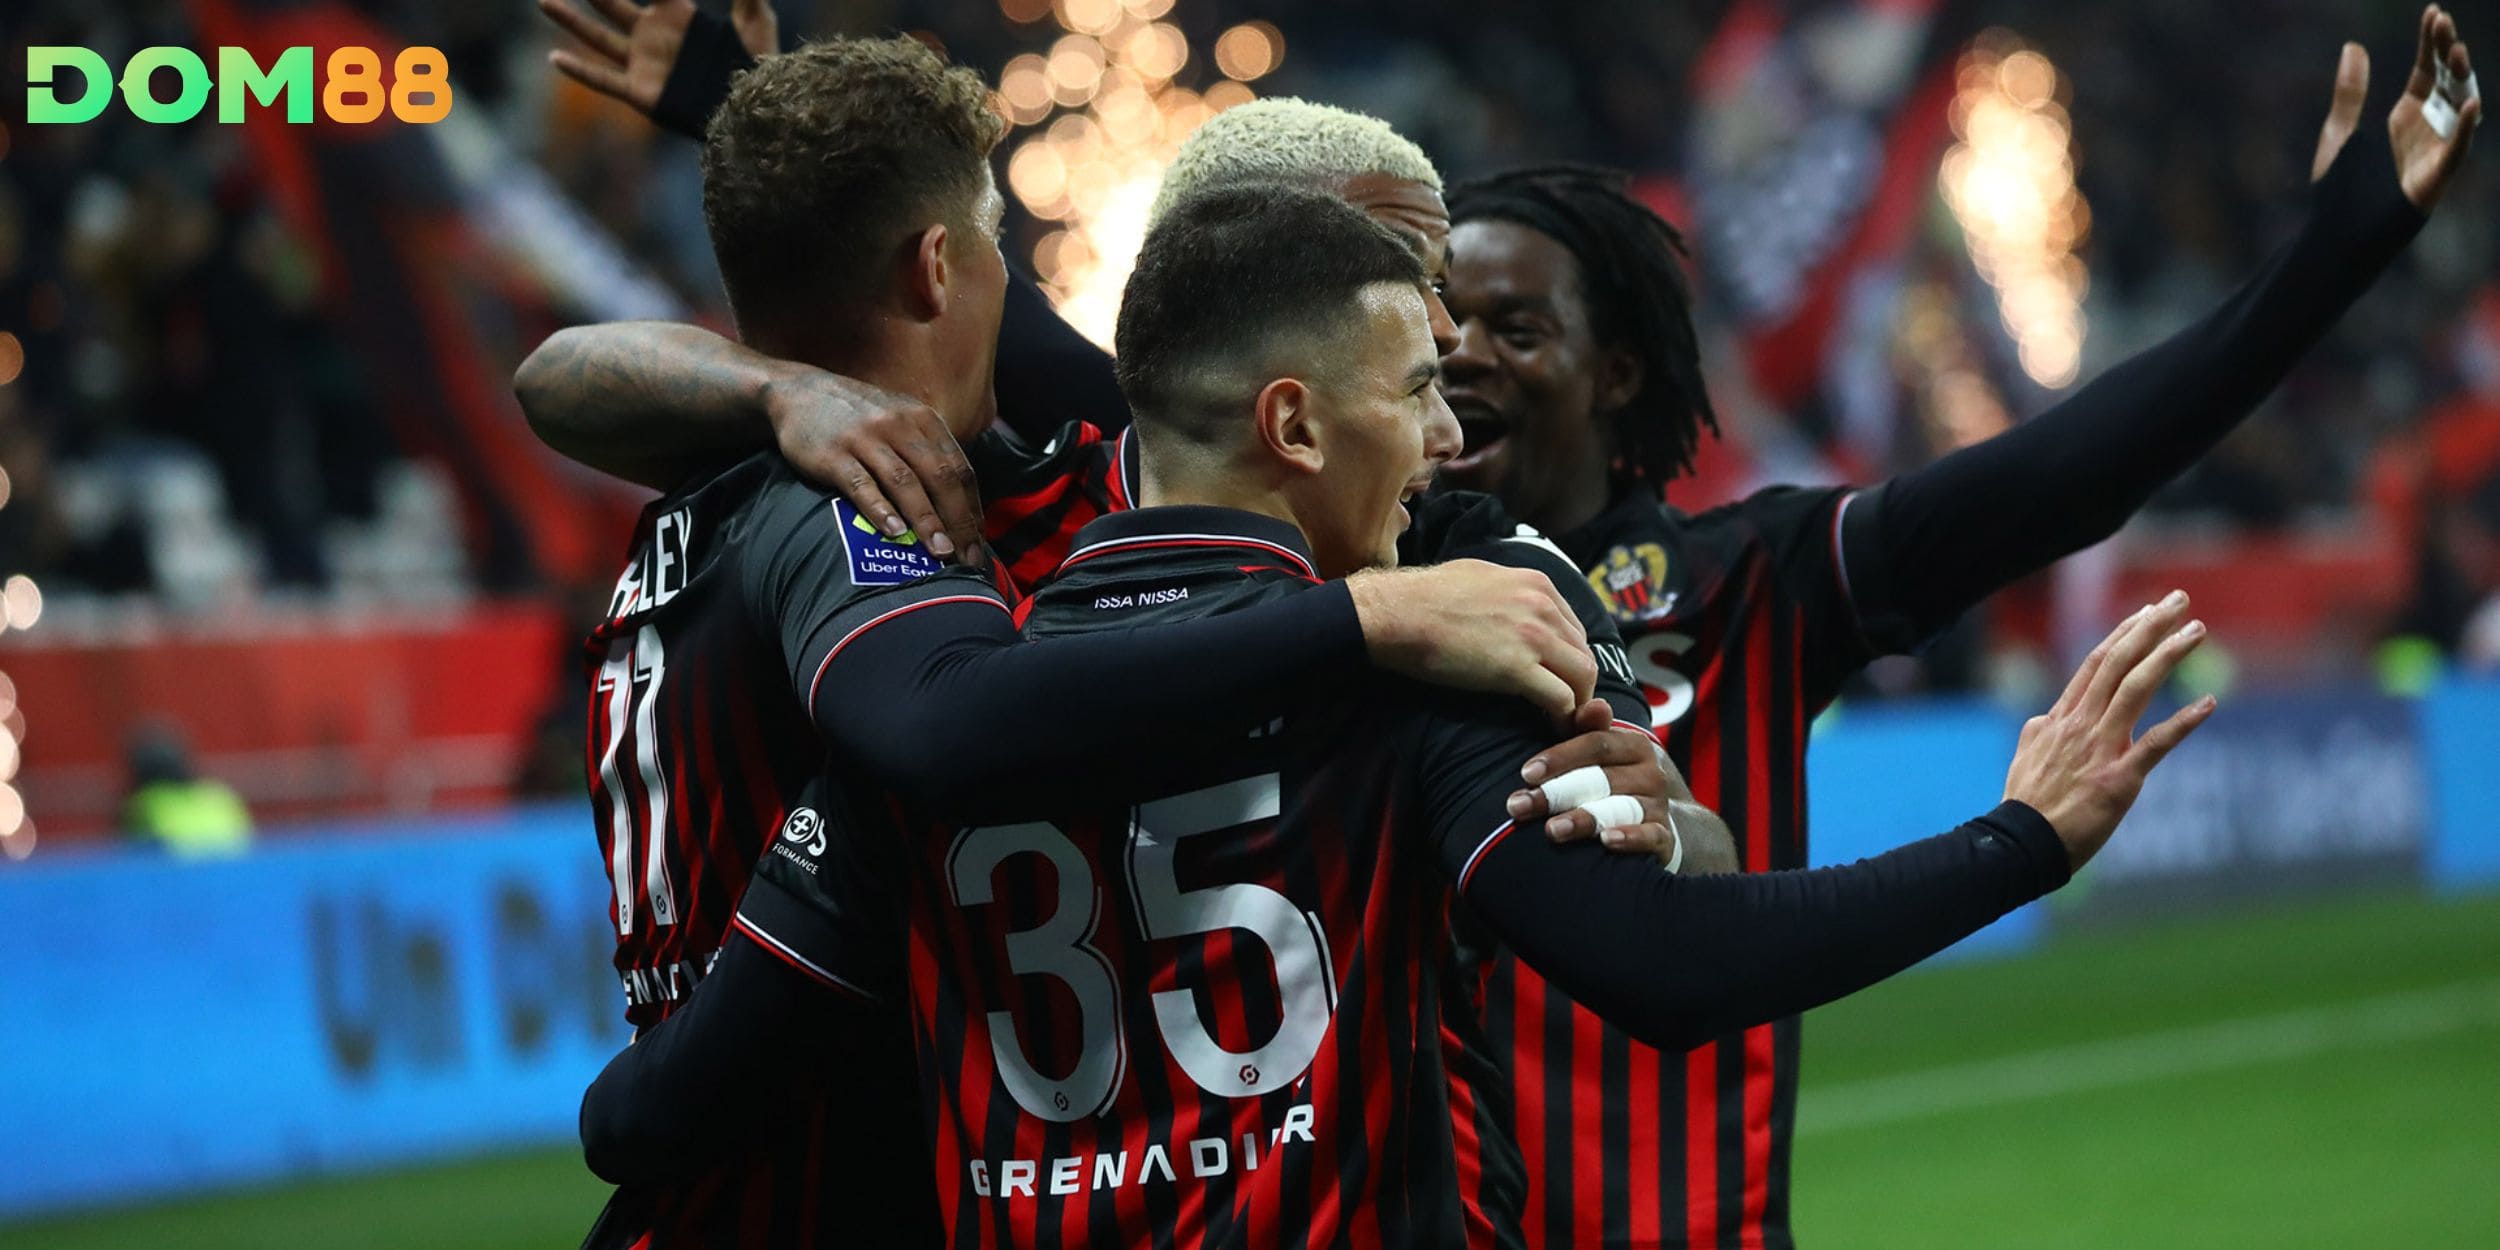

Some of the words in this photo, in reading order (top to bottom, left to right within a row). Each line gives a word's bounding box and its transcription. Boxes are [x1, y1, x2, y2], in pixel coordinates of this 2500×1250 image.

[860, 561, 898, 573] Uber
[864, 548, 917, 564] LIGUE
[921, 557, 929, 566] 1
[1094, 595, 1133, 609] ISSA
[1138, 587, 1189, 606] NISSA
[945, 771, 1338, 1122] 35
[970, 1103, 1316, 1198] GRENADIR
